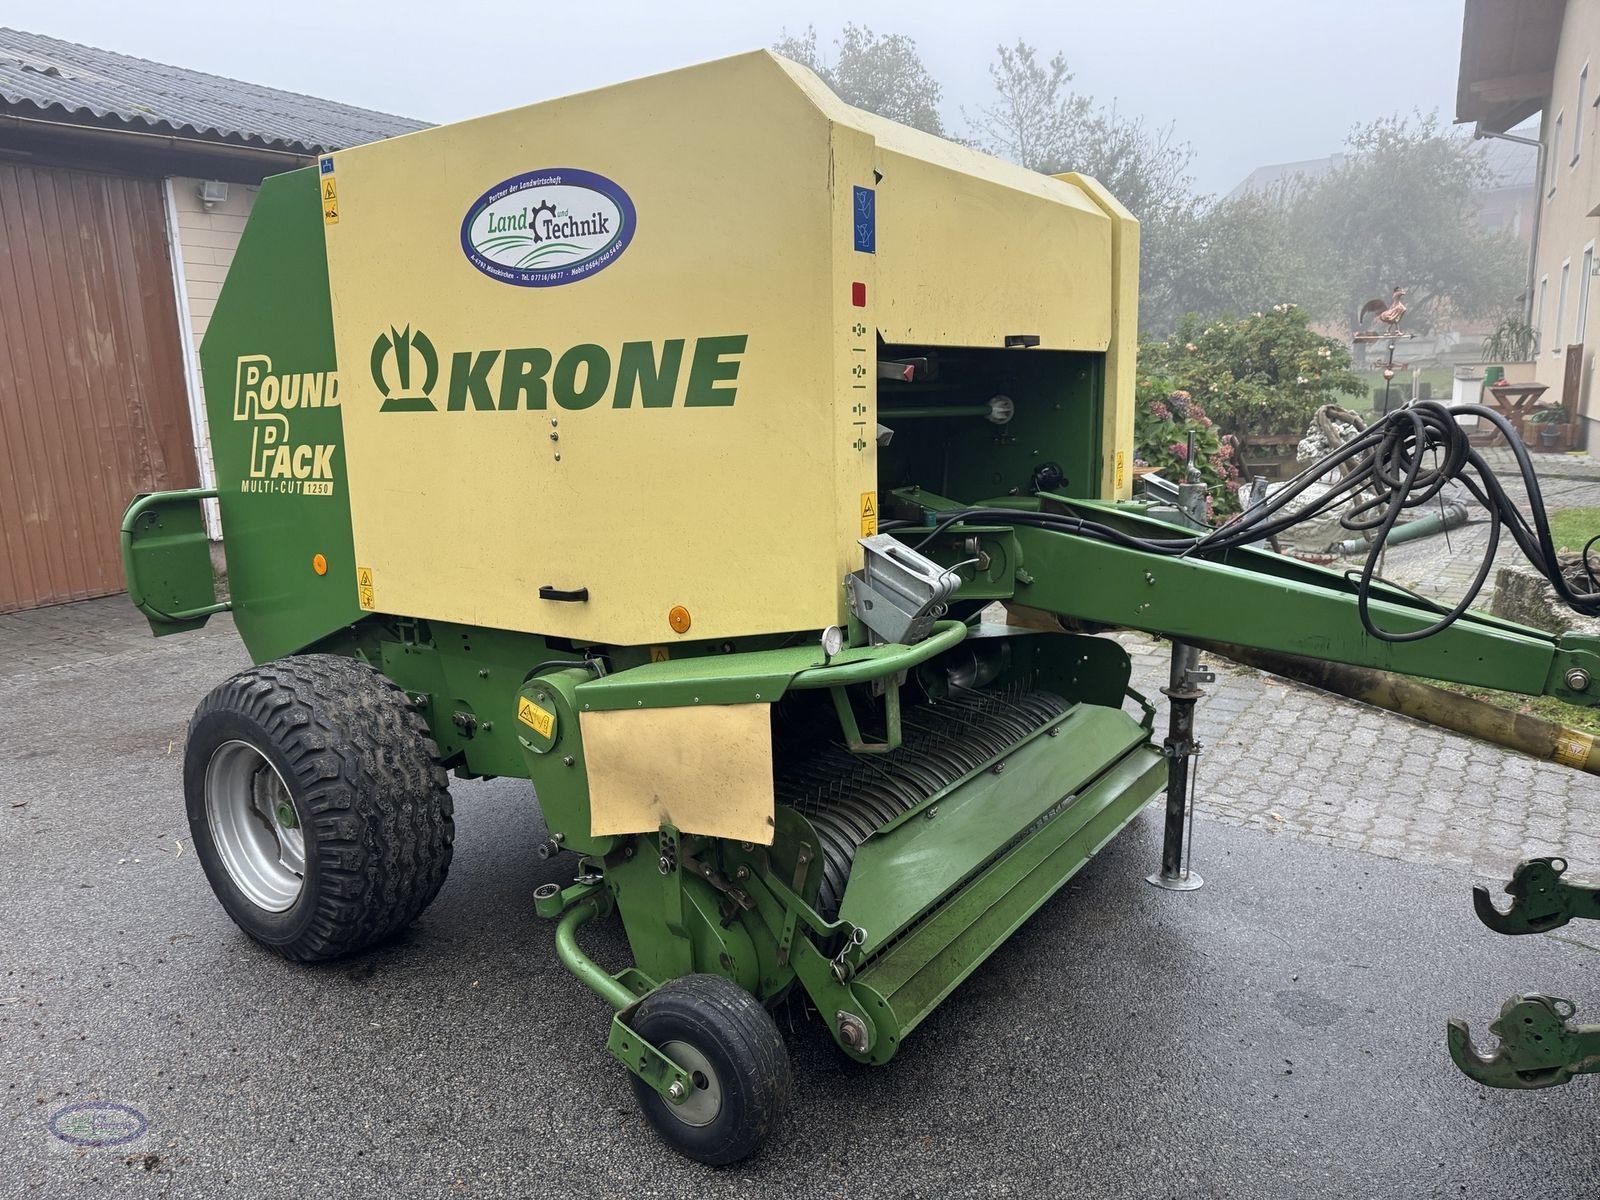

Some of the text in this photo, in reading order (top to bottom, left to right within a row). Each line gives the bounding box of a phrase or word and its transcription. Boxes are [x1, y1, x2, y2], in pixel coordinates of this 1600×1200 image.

[488, 176, 562, 204] Partner der Landwirtschaft
[488, 207, 610, 240] Land und Technik
[233, 354, 341, 421] ROUND
[446, 334, 749, 412] KRONE
[250, 413, 337, 479] PACK
[241, 480, 329, 494] MULTI-CUT 1250
